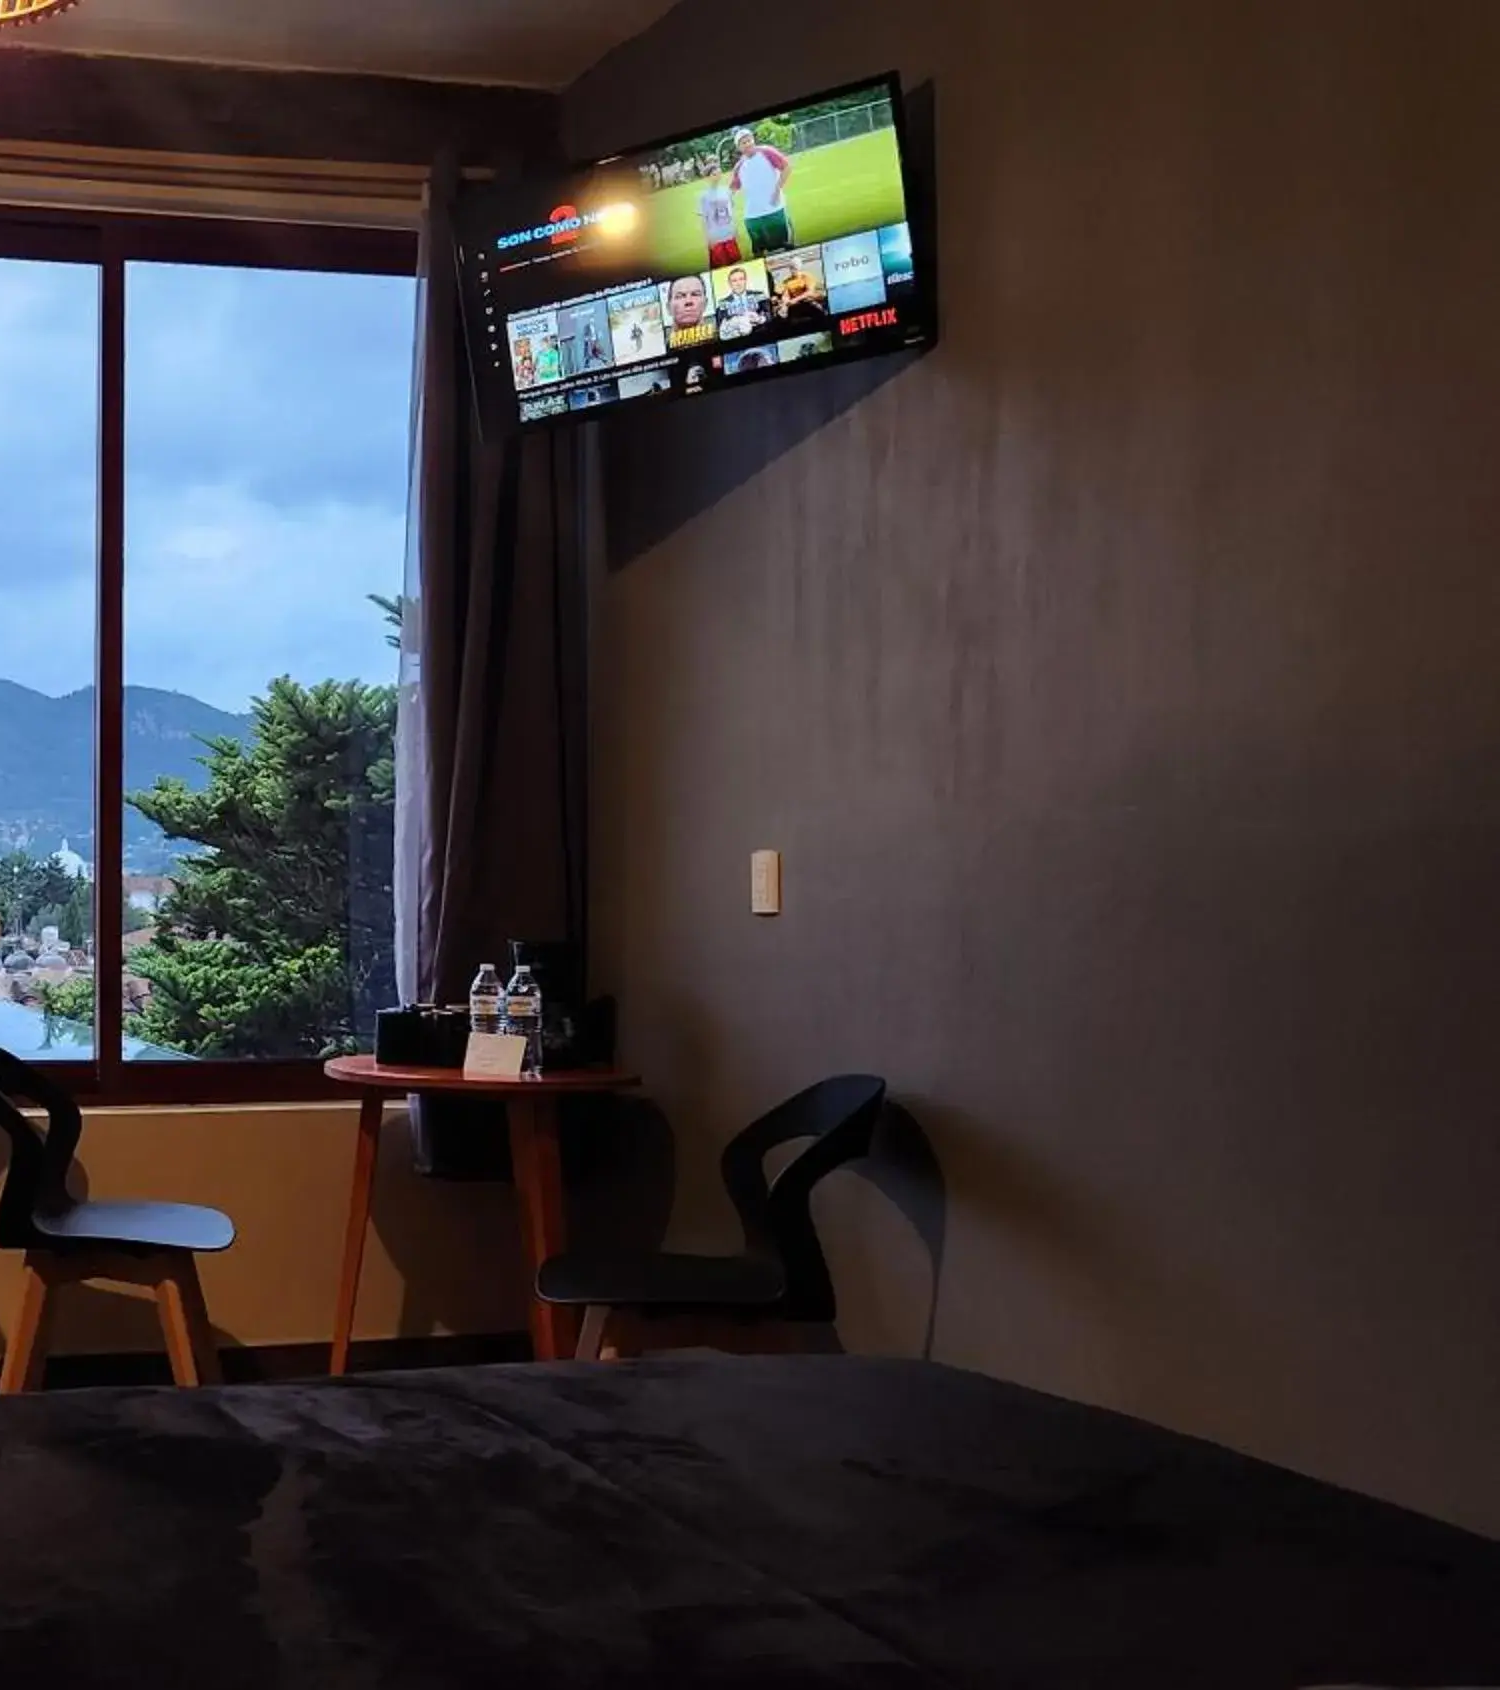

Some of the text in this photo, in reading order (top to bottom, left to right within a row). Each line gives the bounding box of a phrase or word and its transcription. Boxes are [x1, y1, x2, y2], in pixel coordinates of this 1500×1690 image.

[497, 217, 581, 249] SON COMO
[840, 307, 897, 336] NETFLIX
